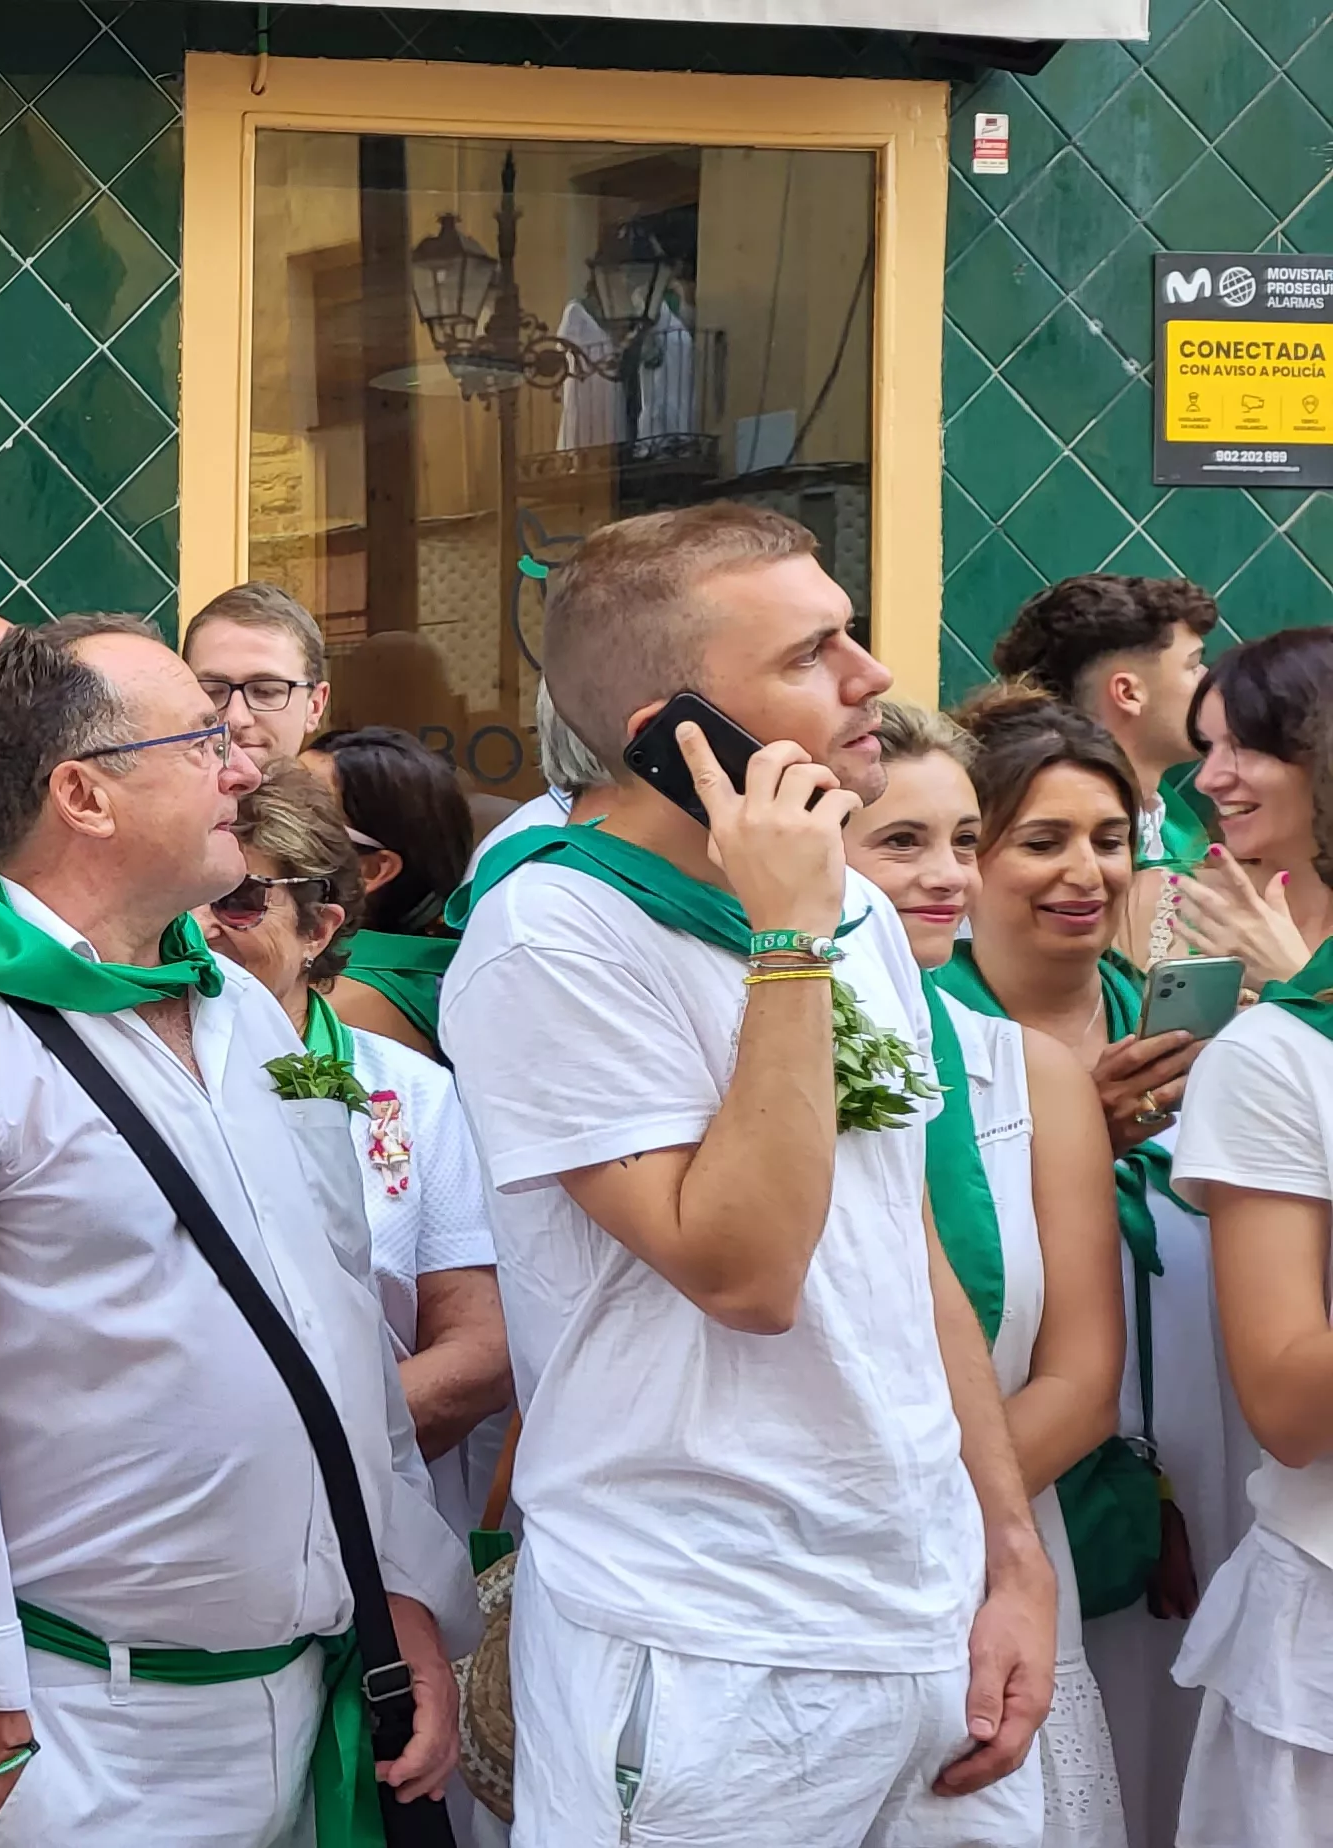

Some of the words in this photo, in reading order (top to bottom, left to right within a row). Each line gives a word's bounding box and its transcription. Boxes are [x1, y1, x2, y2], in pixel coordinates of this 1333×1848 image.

[1267, 267, 1333, 281] MOVISTAR
[1267, 282, 1333, 295] PROSEGU
[1267, 296, 1325, 309] ALARMAS
[1179, 340, 1326, 361] CONECTADA
[1179, 364, 1211, 375] CON
[1213, 364, 1256, 376] AVISO
[1259, 366, 1270, 377] A
[1272, 363, 1326, 378] POLICÍA
